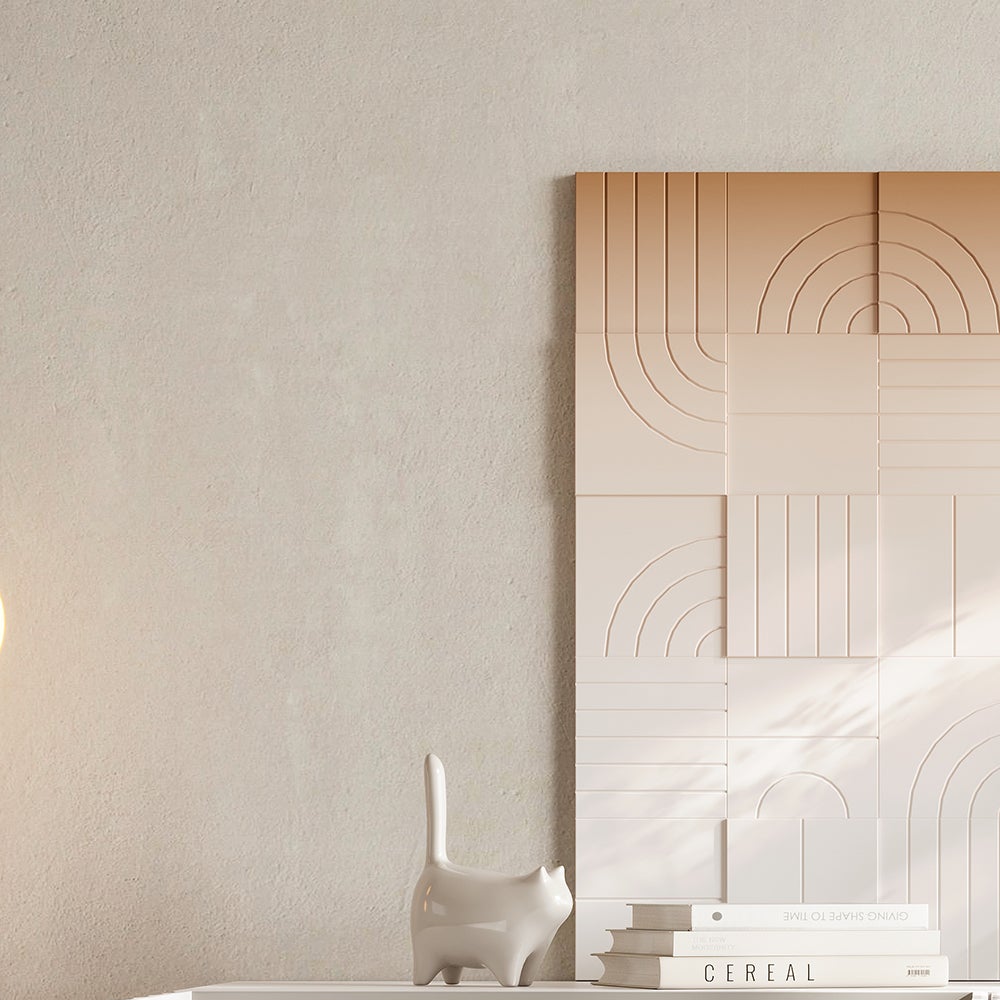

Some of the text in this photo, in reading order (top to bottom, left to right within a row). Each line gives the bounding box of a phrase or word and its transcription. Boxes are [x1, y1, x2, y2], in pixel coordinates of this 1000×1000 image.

[784, 911, 908, 920] GIVING SHAPE TO TIME
[704, 963, 816, 983] CEREAL
